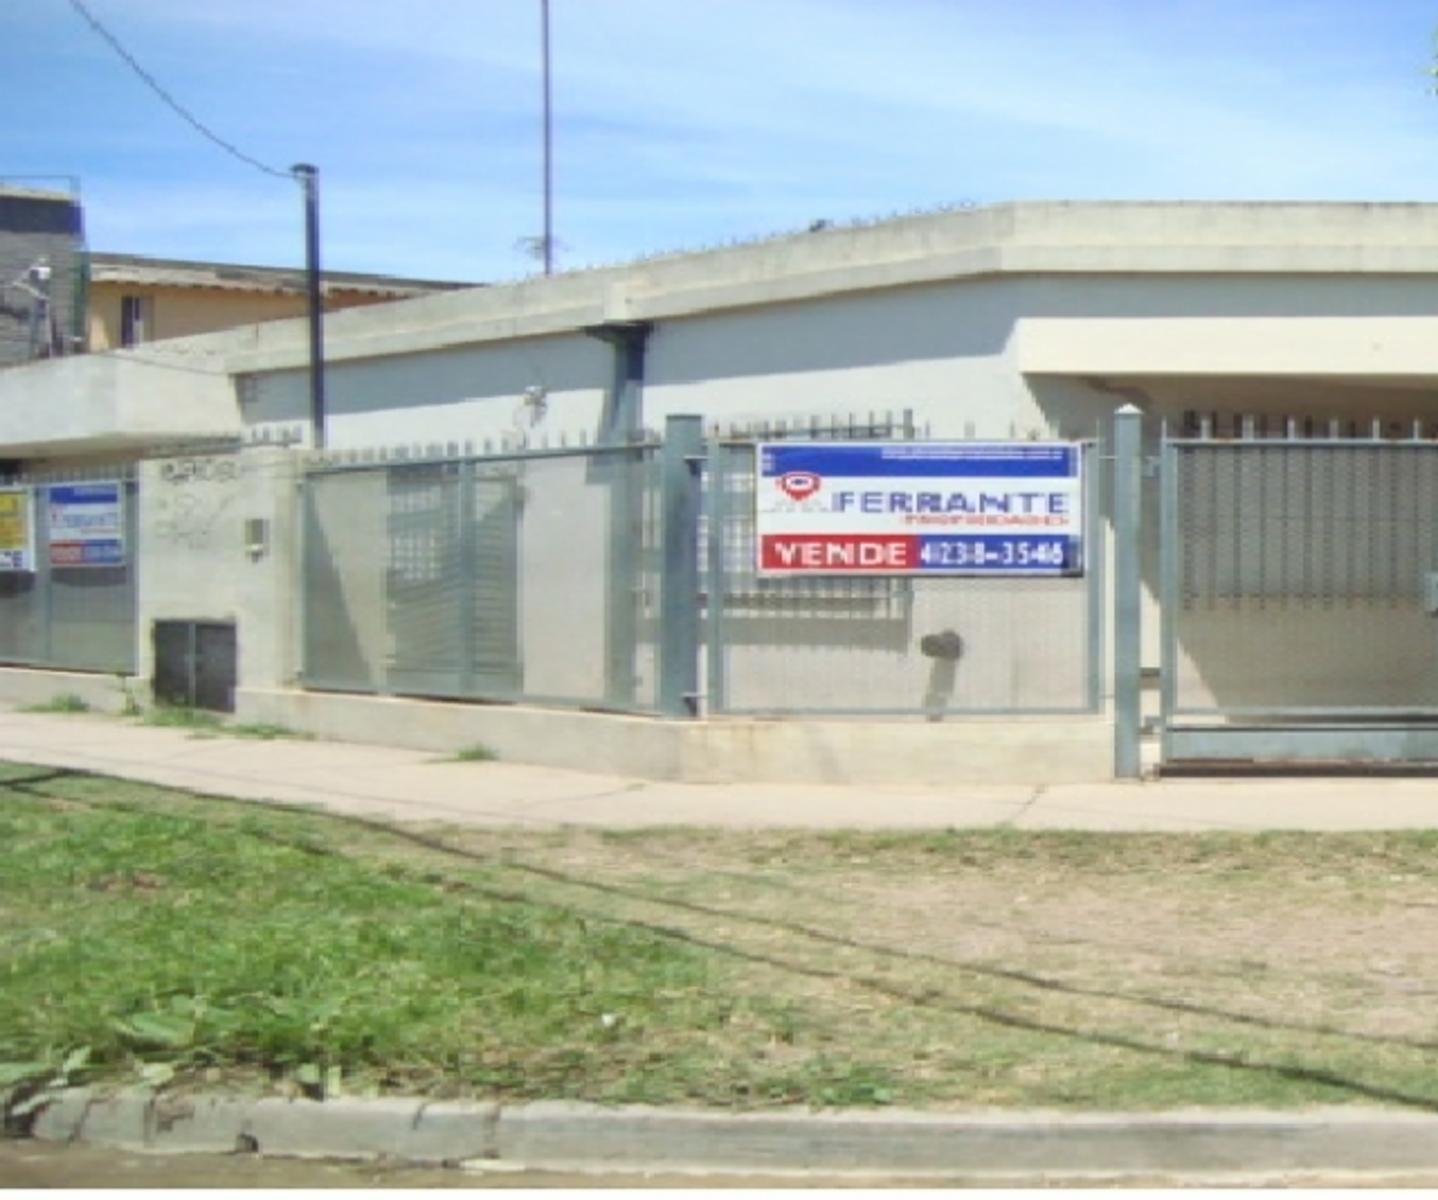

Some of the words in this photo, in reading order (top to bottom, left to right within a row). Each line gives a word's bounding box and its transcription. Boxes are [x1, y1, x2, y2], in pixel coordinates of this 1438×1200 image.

[834, 491, 1069, 514] FERRANTE
[774, 541, 907, 566] VENDE
[920, 541, 1064, 566] 4238-3546
